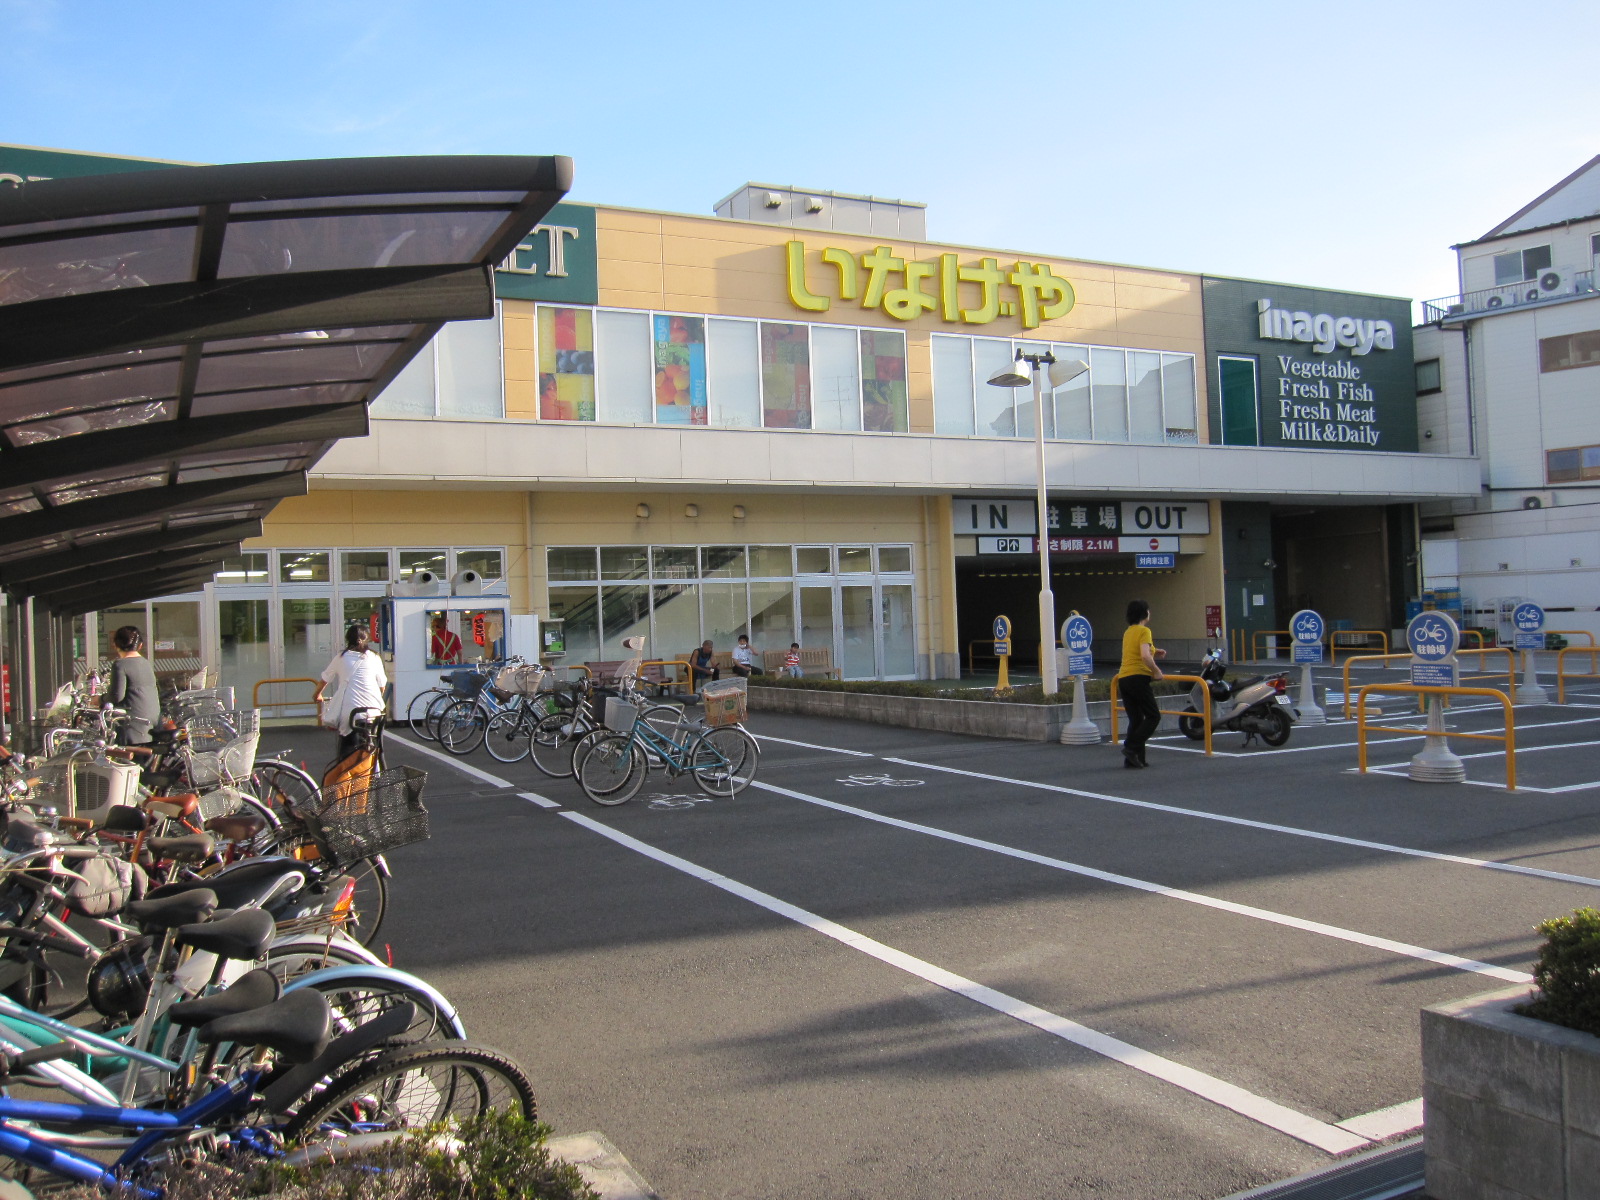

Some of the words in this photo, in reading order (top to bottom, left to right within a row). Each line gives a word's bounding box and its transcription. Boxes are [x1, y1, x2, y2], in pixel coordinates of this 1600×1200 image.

[786, 240, 1076, 329] いなげや
[1277, 355, 1360, 380] Vegetable
[1278, 377, 1330, 399] Fresh
[1337, 381, 1374, 402] Fish
[1279, 399, 1331, 420] Fresh
[1336, 403, 1376, 423] Meat
[1280, 421, 1380, 446] Milk&Daily
[971, 504, 1008, 529] IN
[1135, 506, 1188, 530] OUT
[1086, 540, 1113, 550] 2.1M
[1416, 644, 1446, 655] 駐輪場
